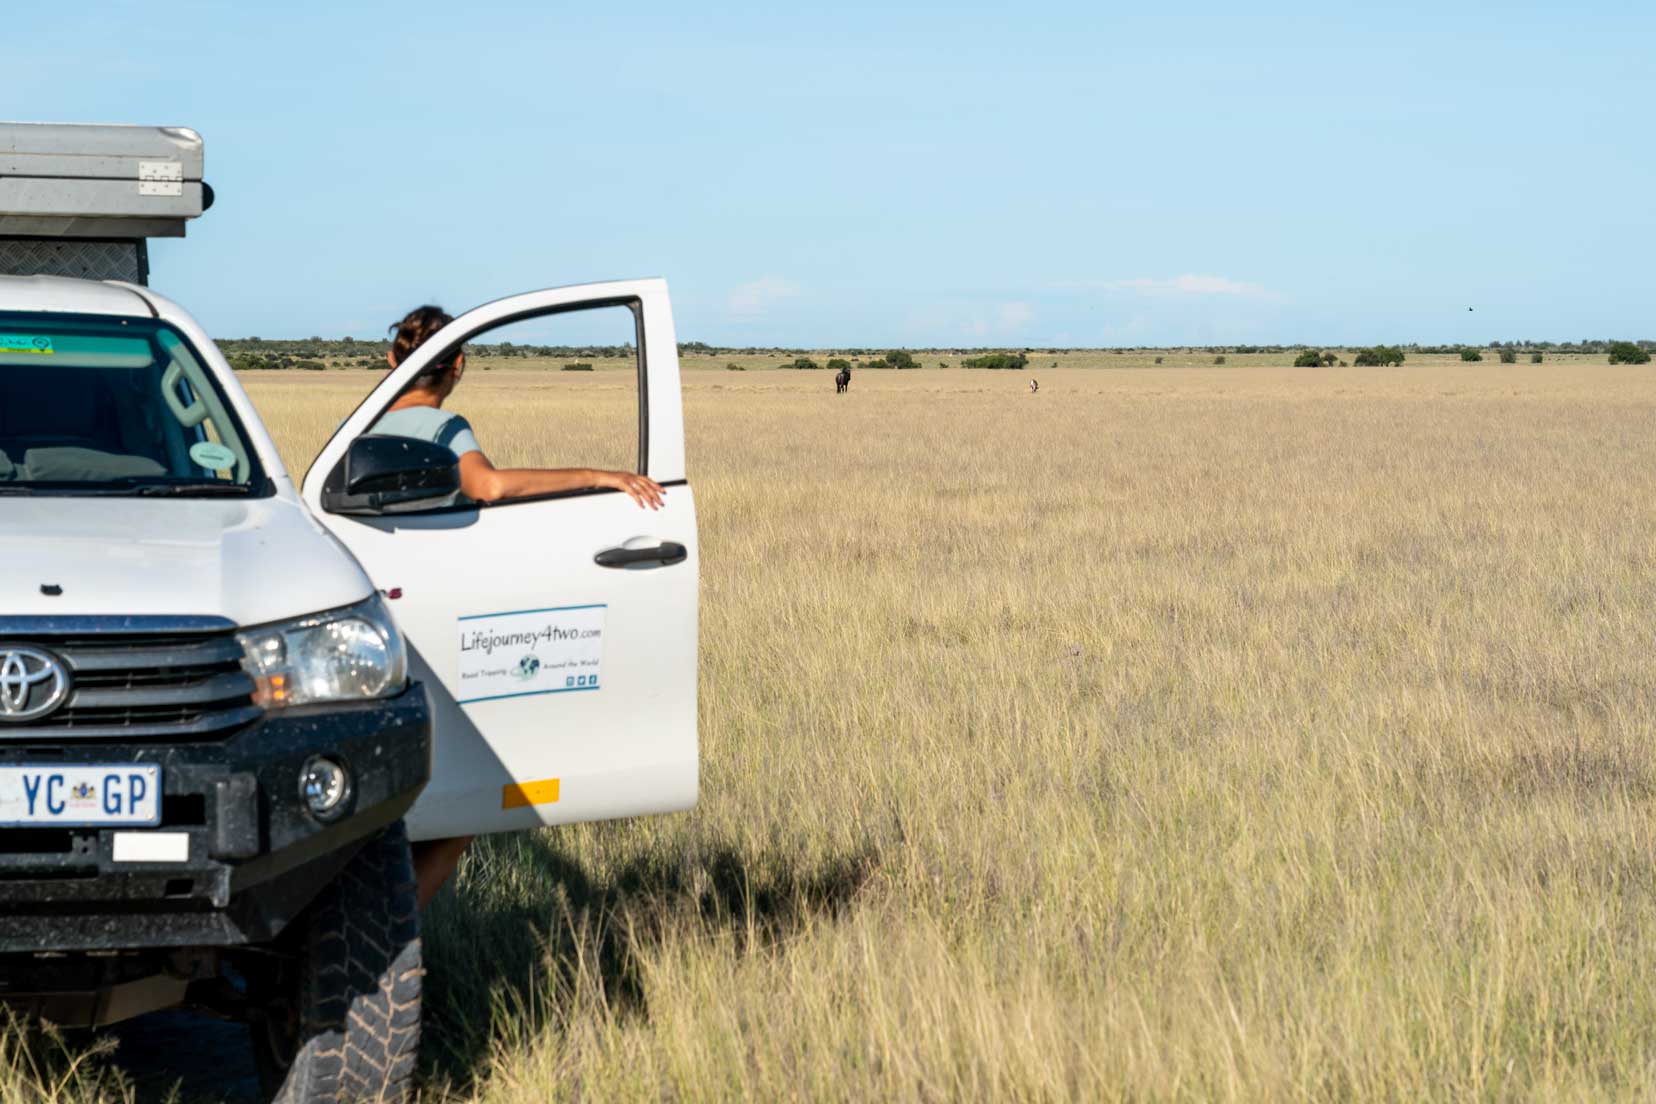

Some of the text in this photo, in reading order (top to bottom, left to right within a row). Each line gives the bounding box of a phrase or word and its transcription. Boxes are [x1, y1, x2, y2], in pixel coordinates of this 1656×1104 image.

[461, 624, 602, 655] Lifejourney4two.com
[22, 774, 147, 816] YC GP
